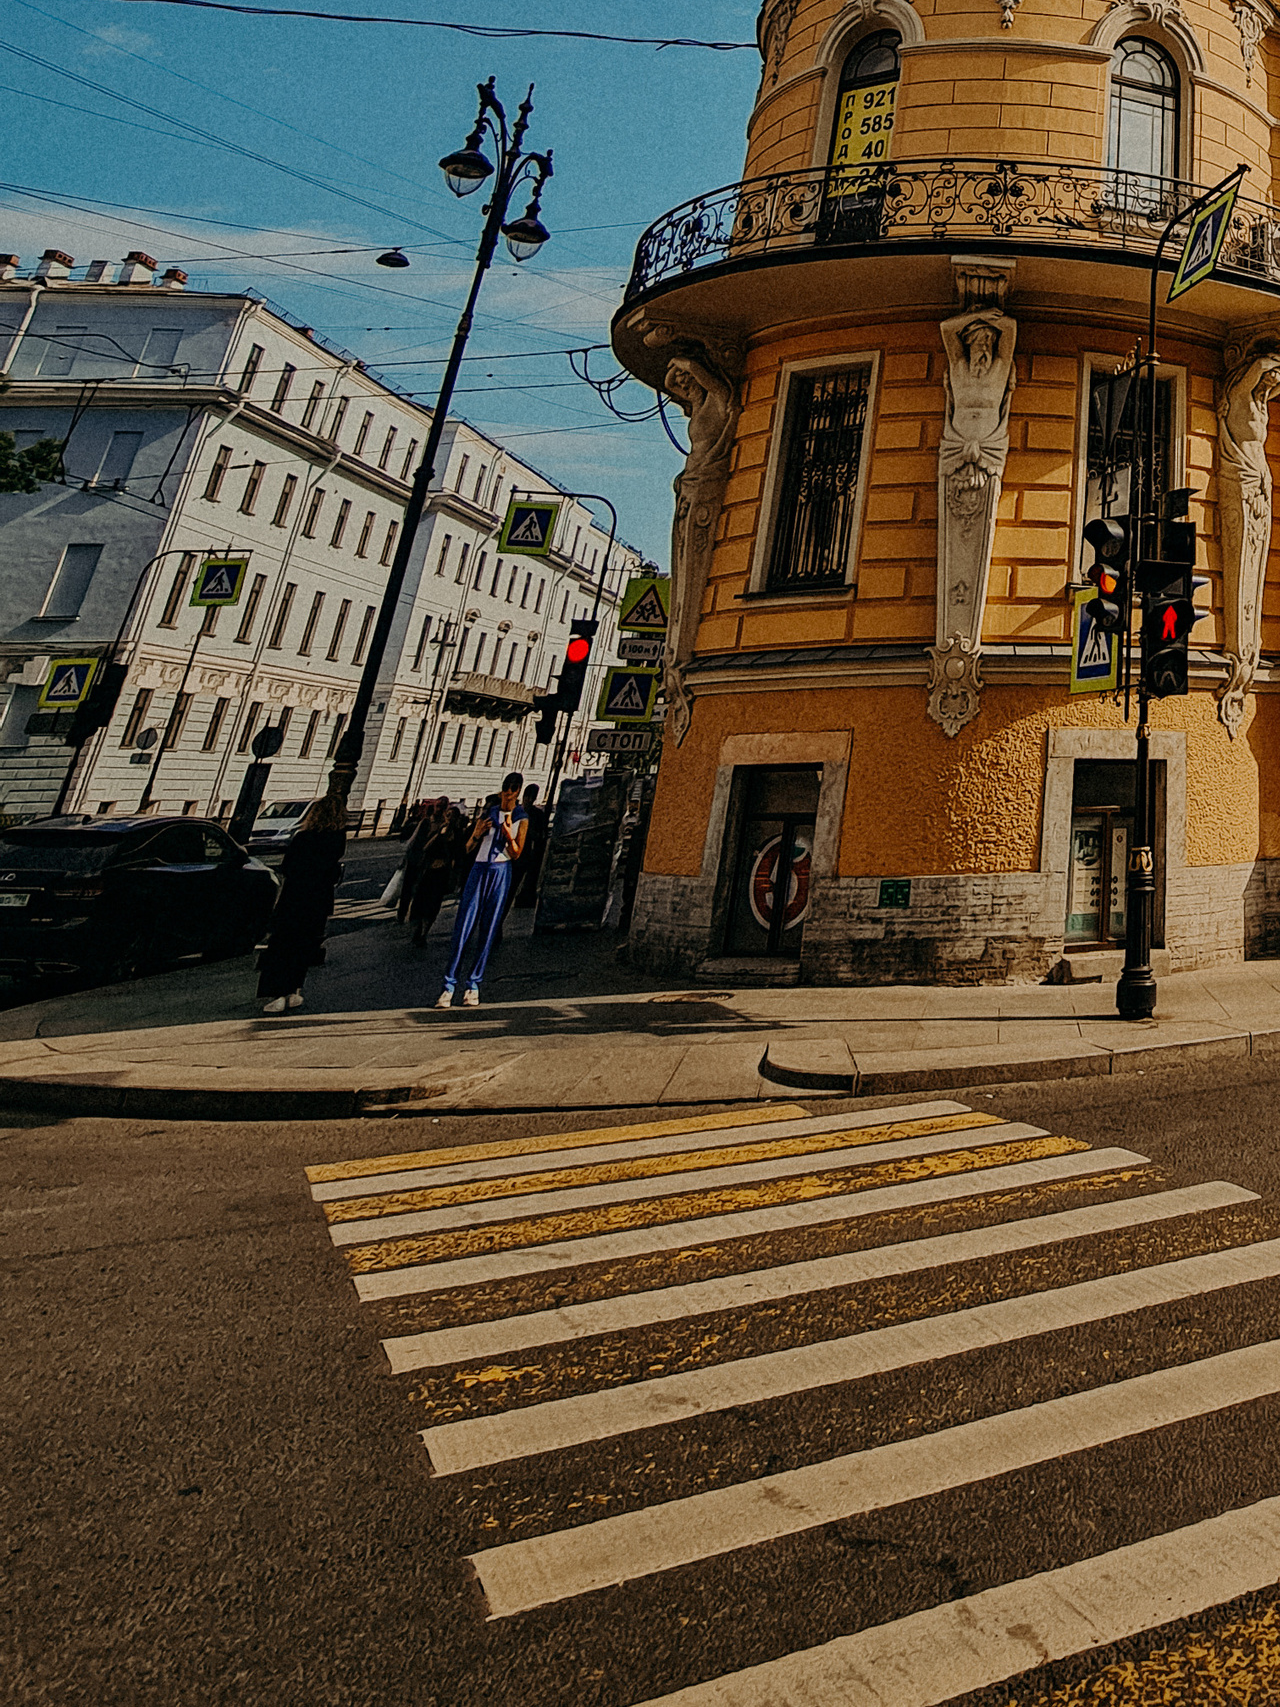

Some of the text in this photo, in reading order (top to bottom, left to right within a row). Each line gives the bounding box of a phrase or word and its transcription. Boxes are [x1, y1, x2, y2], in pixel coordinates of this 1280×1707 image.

[863, 86, 897, 109] 921
[859, 112, 895, 135] 585
[861, 139, 885, 160] 40
[596, 733, 645, 749] СТОП
